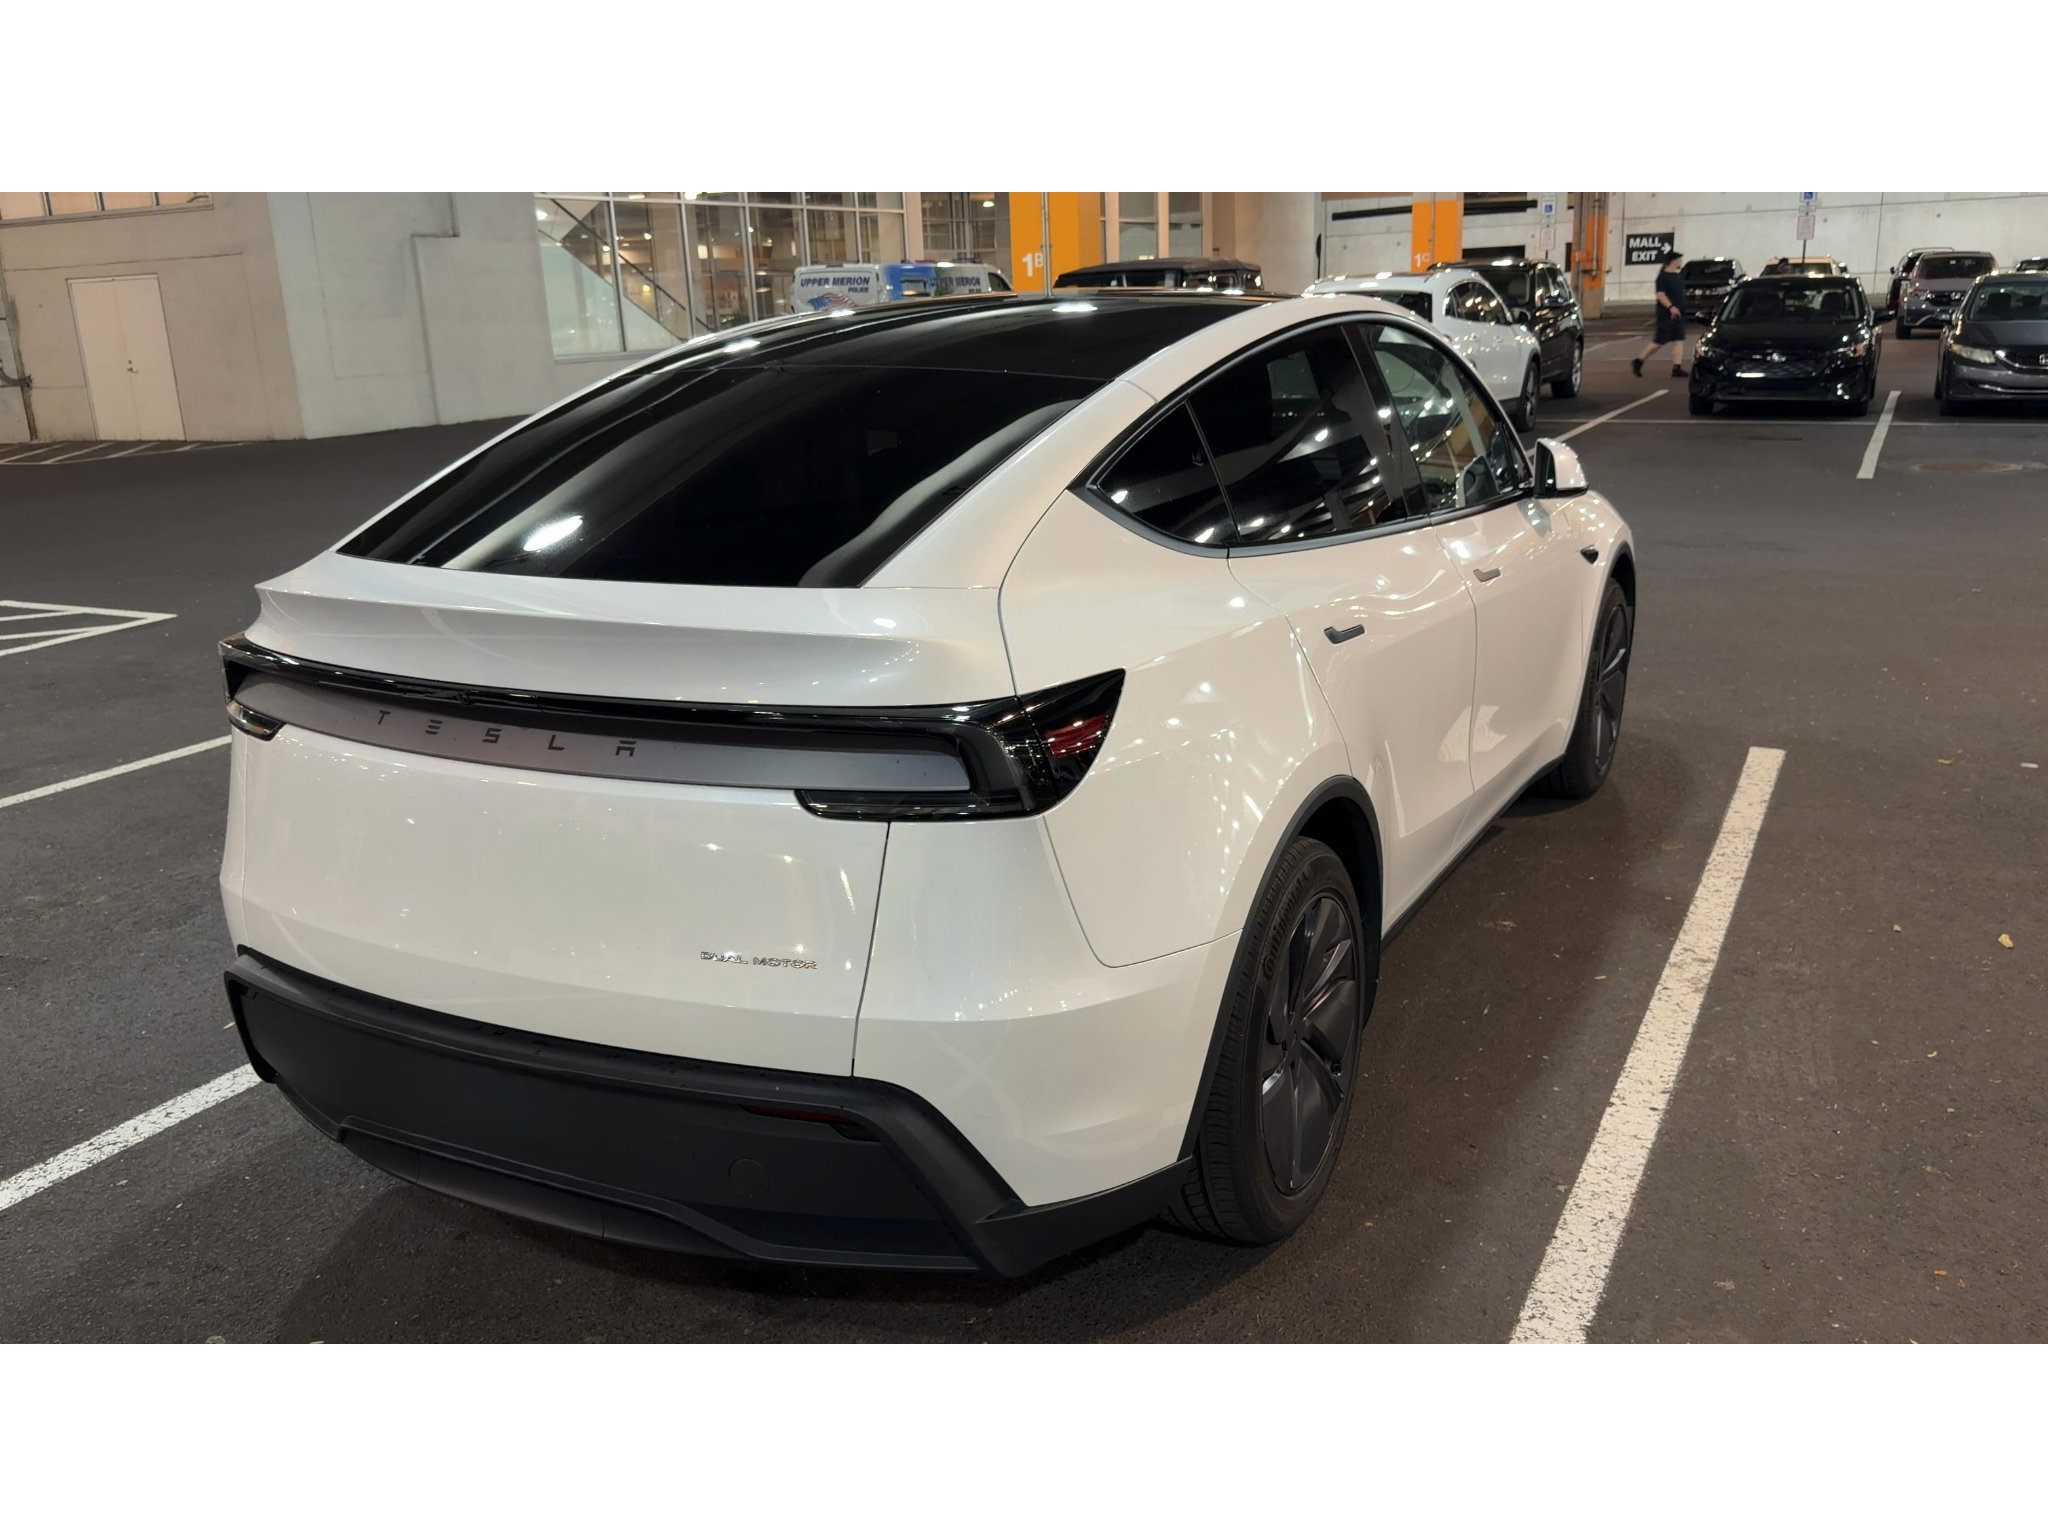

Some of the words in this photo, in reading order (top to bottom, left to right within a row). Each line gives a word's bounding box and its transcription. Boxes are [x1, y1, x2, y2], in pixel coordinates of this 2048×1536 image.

[1629, 236, 1662, 248] MALL
[1631, 250, 1658, 262] EXIT
[801, 278, 830, 287] UPPER
[832, 277, 870, 286] MERION
[376, 709, 637, 757] TESLA
[700, 951, 749, 965] DUAL
[752, 957, 818, 969] MOTOR
